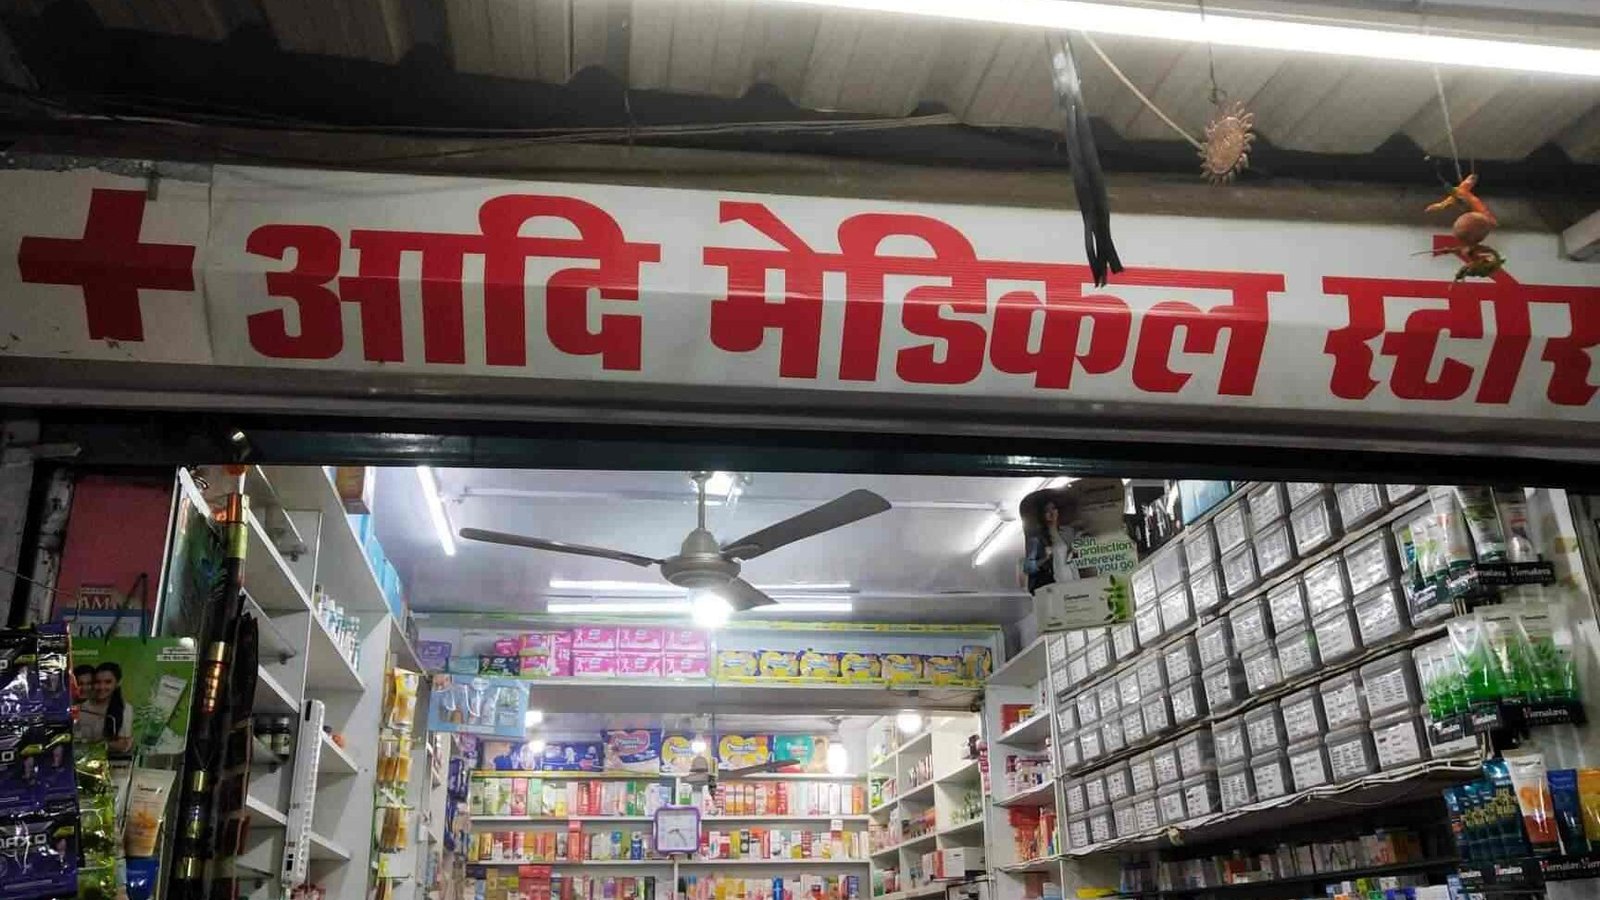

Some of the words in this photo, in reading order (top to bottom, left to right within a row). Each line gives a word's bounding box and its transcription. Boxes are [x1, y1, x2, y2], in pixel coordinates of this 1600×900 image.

[245, 194, 661, 371] आदि
[703, 201, 1285, 396] मेडिकल
[1073, 536, 1097, 548] Skin
[1080, 542, 1132, 558] protection
[1074, 553, 1126, 567] wherever
[1098, 562, 1118, 574] you
[1119, 560, 1134, 572] go
